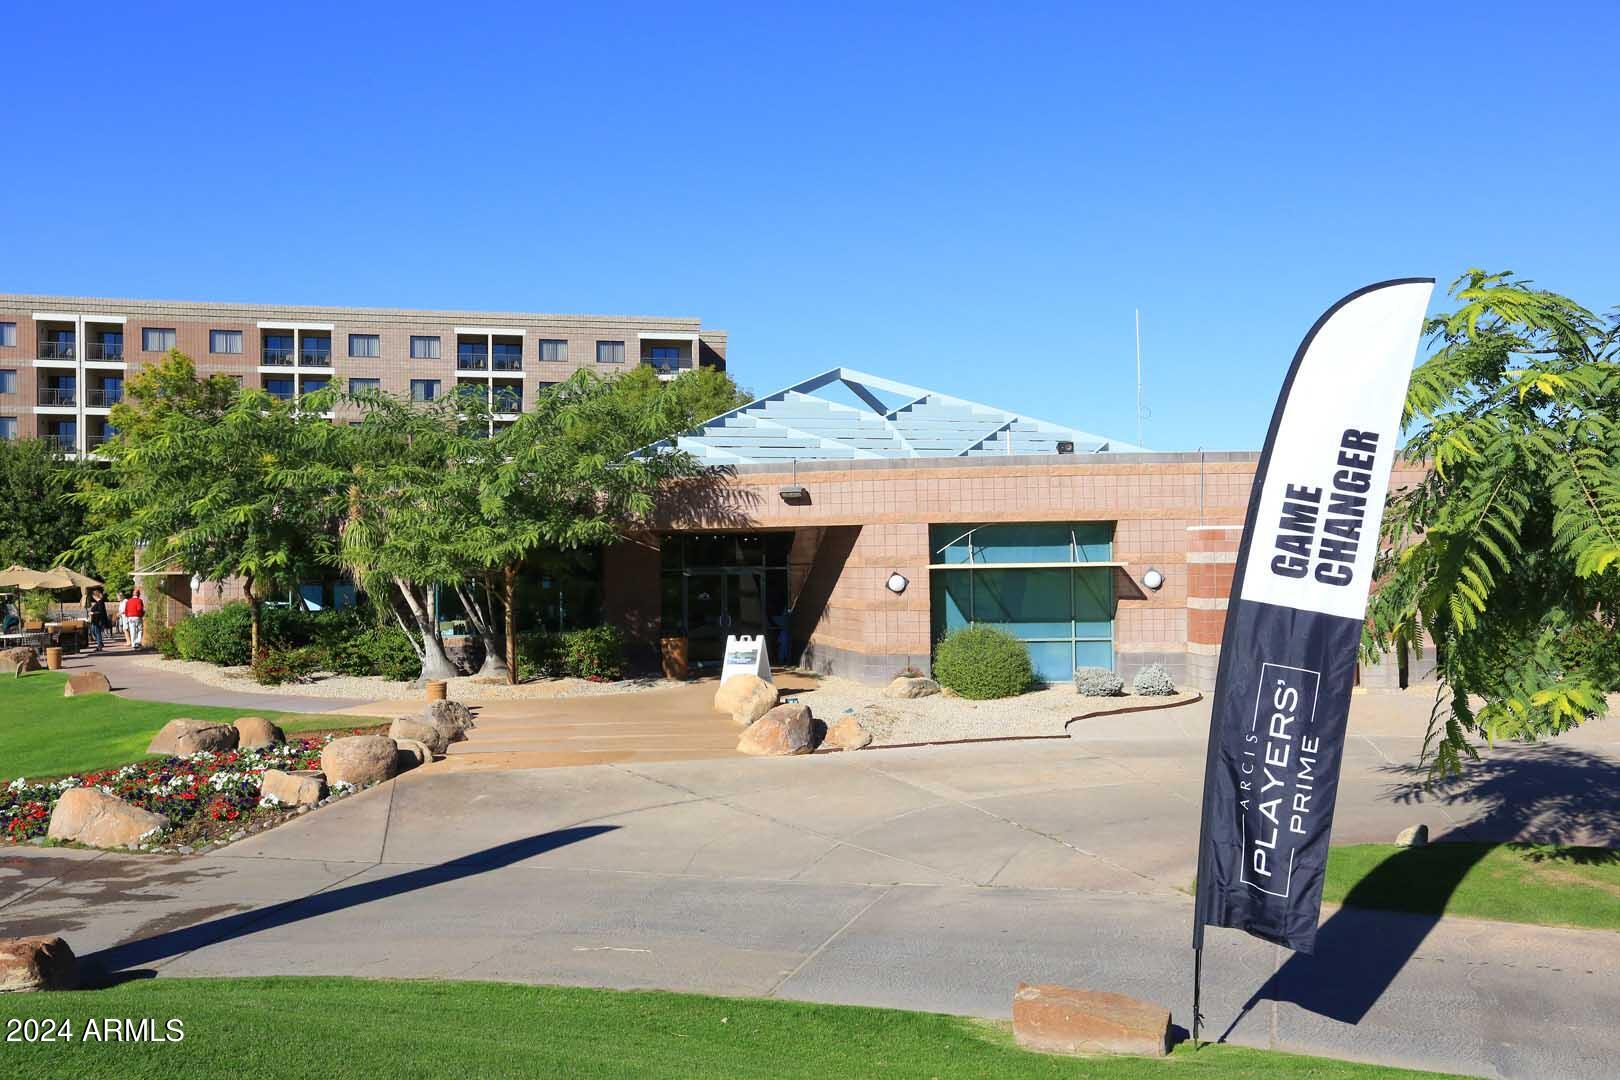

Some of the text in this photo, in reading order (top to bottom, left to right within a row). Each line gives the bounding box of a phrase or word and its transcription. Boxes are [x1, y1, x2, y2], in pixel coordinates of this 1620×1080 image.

[1270, 483, 1323, 579] GAME
[1314, 428, 1380, 587] CHANGER
[1239, 734, 1258, 811] ARCIS
[1253, 679, 1299, 877] PLAYERS'
[1289, 735, 1320, 835] PRIME
